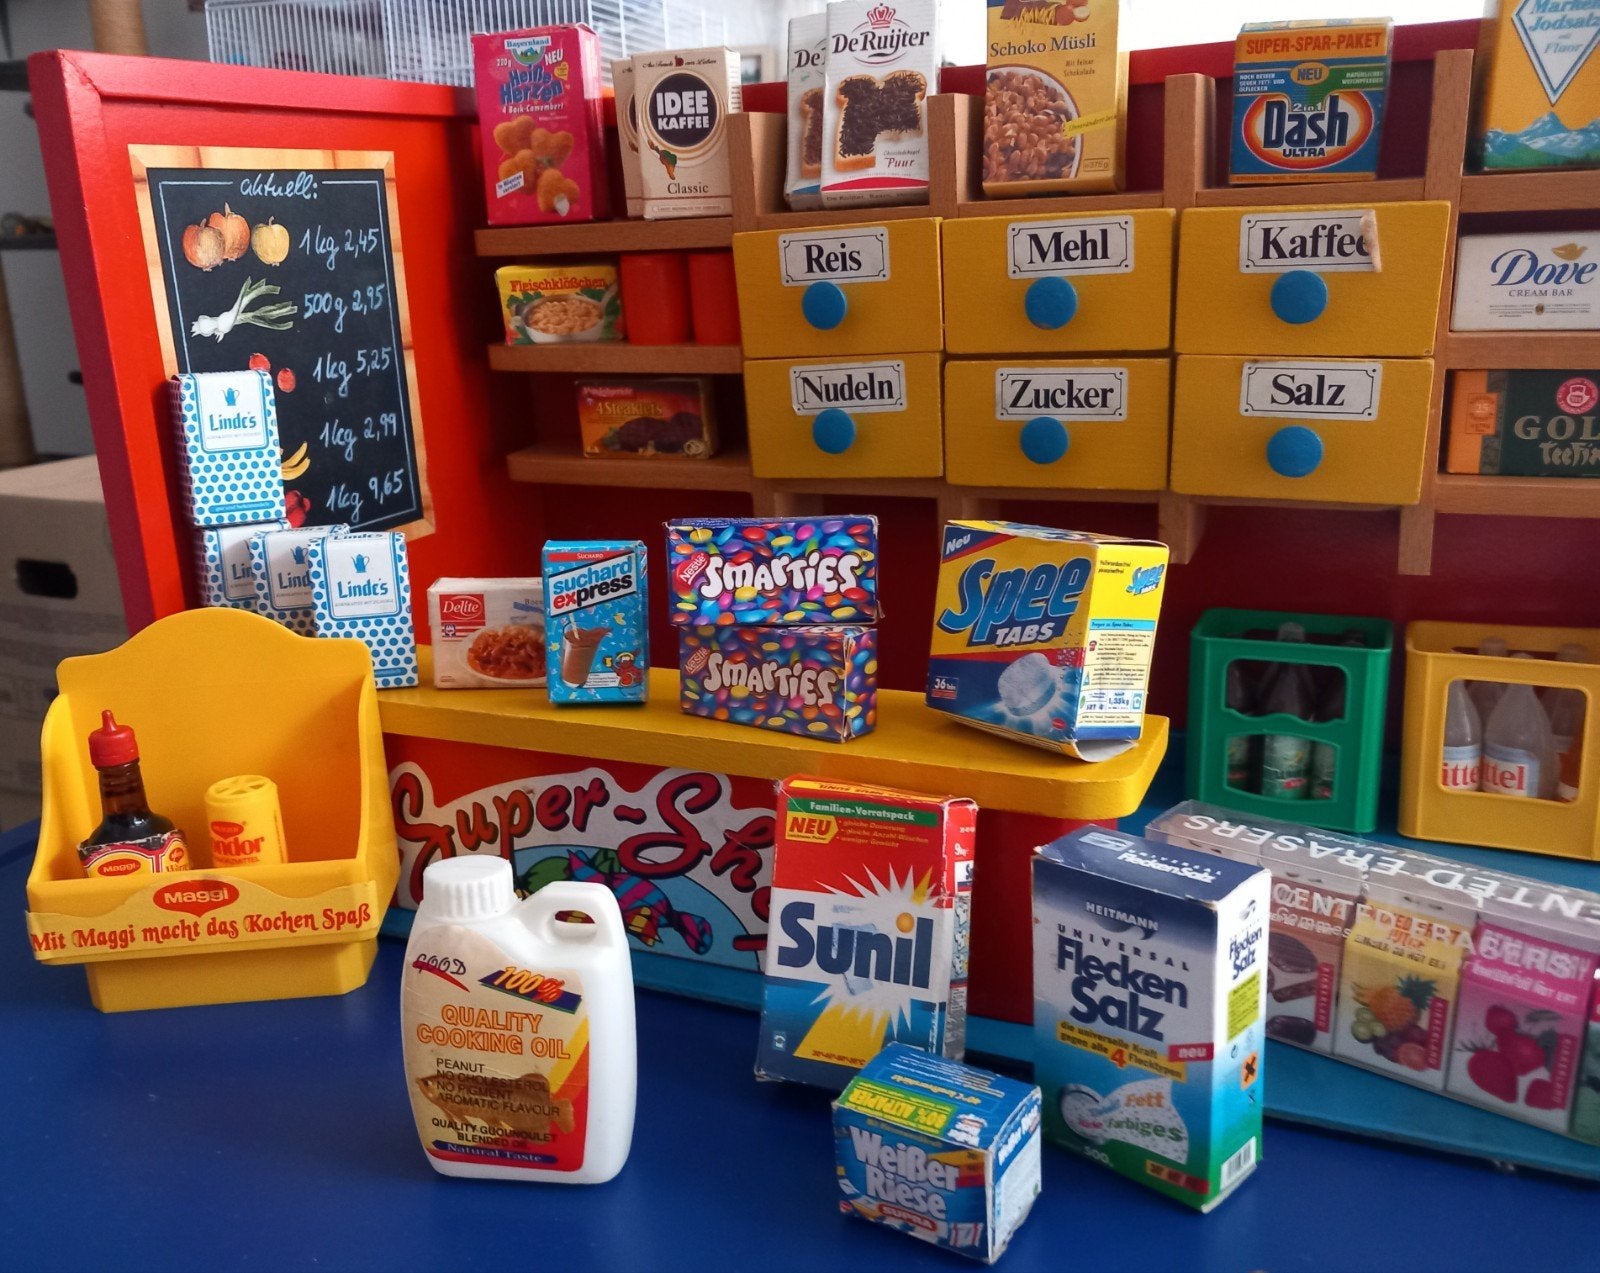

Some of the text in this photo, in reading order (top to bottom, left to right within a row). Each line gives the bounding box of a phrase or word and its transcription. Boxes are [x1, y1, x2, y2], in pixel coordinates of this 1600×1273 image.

[506, 38, 550, 48] Bayernland
[831, 28, 930, 57] De Ruijter
[989, 32, 1096, 58] Schoko Müsli
[1246, 32, 1382, 56] SUPER-SPAR-PAKET
[544, 48, 564, 66] NEU
[1297, 67, 1323, 81] NEU
[500, 80, 564, 106] Herzen
[656, 90, 708, 116] IDEE
[1292, 102, 1323, 111] 2 in 1
[657, 115, 710, 130] KAFFEE
[1262, 94, 1349, 149] Dash
[885, 157, 915, 168] Puur
[1282, 148, 1326, 158] ULTRA
[667, 181, 709, 194] Classic
[344, 228, 379, 258] 2,45
[1026, 228, 1111, 265] Mehl
[803, 242, 863, 274] Reis
[1490, 248, 1598, 287] Dove
[509, 277, 606, 293] Fleischklößchen
[1508, 289, 1574, 298] CREAM BAR
[351, 283, 386, 315] 2,95
[356, 347, 391, 377] 5,25
[800, 373, 894, 404] Nudeln
[1009, 378, 1114, 410] Zucker
[1270, 372, 1347, 407] Salz
[596, 402, 603, 415] 4
[364, 412, 398, 442] 2,99
[1514, 415, 1600, 440] GOL
[368, 468, 404, 504] 9,65
[945, 533, 971, 555] Neu
[553, 556, 633, 595] suchard
[553, 574, 633, 610] express
[936, 556, 1093, 644] Spee
[443, 600, 479, 614] Delite
[994, 621, 1056, 646] TABS
[934, 676, 946, 690] 36
[810, 801, 915, 822] Familien-Vorratspack
[788, 816, 832, 836] NEU
[391, 771, 776, 923] Super-Sh
[31, 903, 371, 952] Mit Maggi macht das Kochen Spaß
[1086, 902, 1159, 931] HEITMANN
[777, 901, 934, 989] Sunil
[1057, 923, 1190, 972] UNIVERSAL
[415, 953, 467, 975] GOOD
[1057, 934, 1189, 1010] Flecken
[493, 966, 565, 1003] 100%
[441, 1004, 543, 1034] QUALITY
[1070, 975, 1165, 1042] Salz
[416, 1023, 571, 1060] COOKING OIL
[1178, 1046, 1207, 1059] neu
[436, 1057, 486, 1073] PEANUT
[1110, 1048, 1126, 1068] 4
[436, 1069, 549, 1093] NO CHOLESTEROL
[436, 1081, 513, 1100] NO PIGMENT
[437, 1092, 560, 1117] AROMATIC FLAVOUR
[431, 1117, 478, 1132] QUALITY
[1107, 1117, 1185, 1143] farbiges
[447, 1142, 543, 1163] Natural Taste
[457, 1133, 509, 1148] BLENDED
[849, 1125, 960, 1192] Weißer
[866, 1164, 947, 1220] Riese
